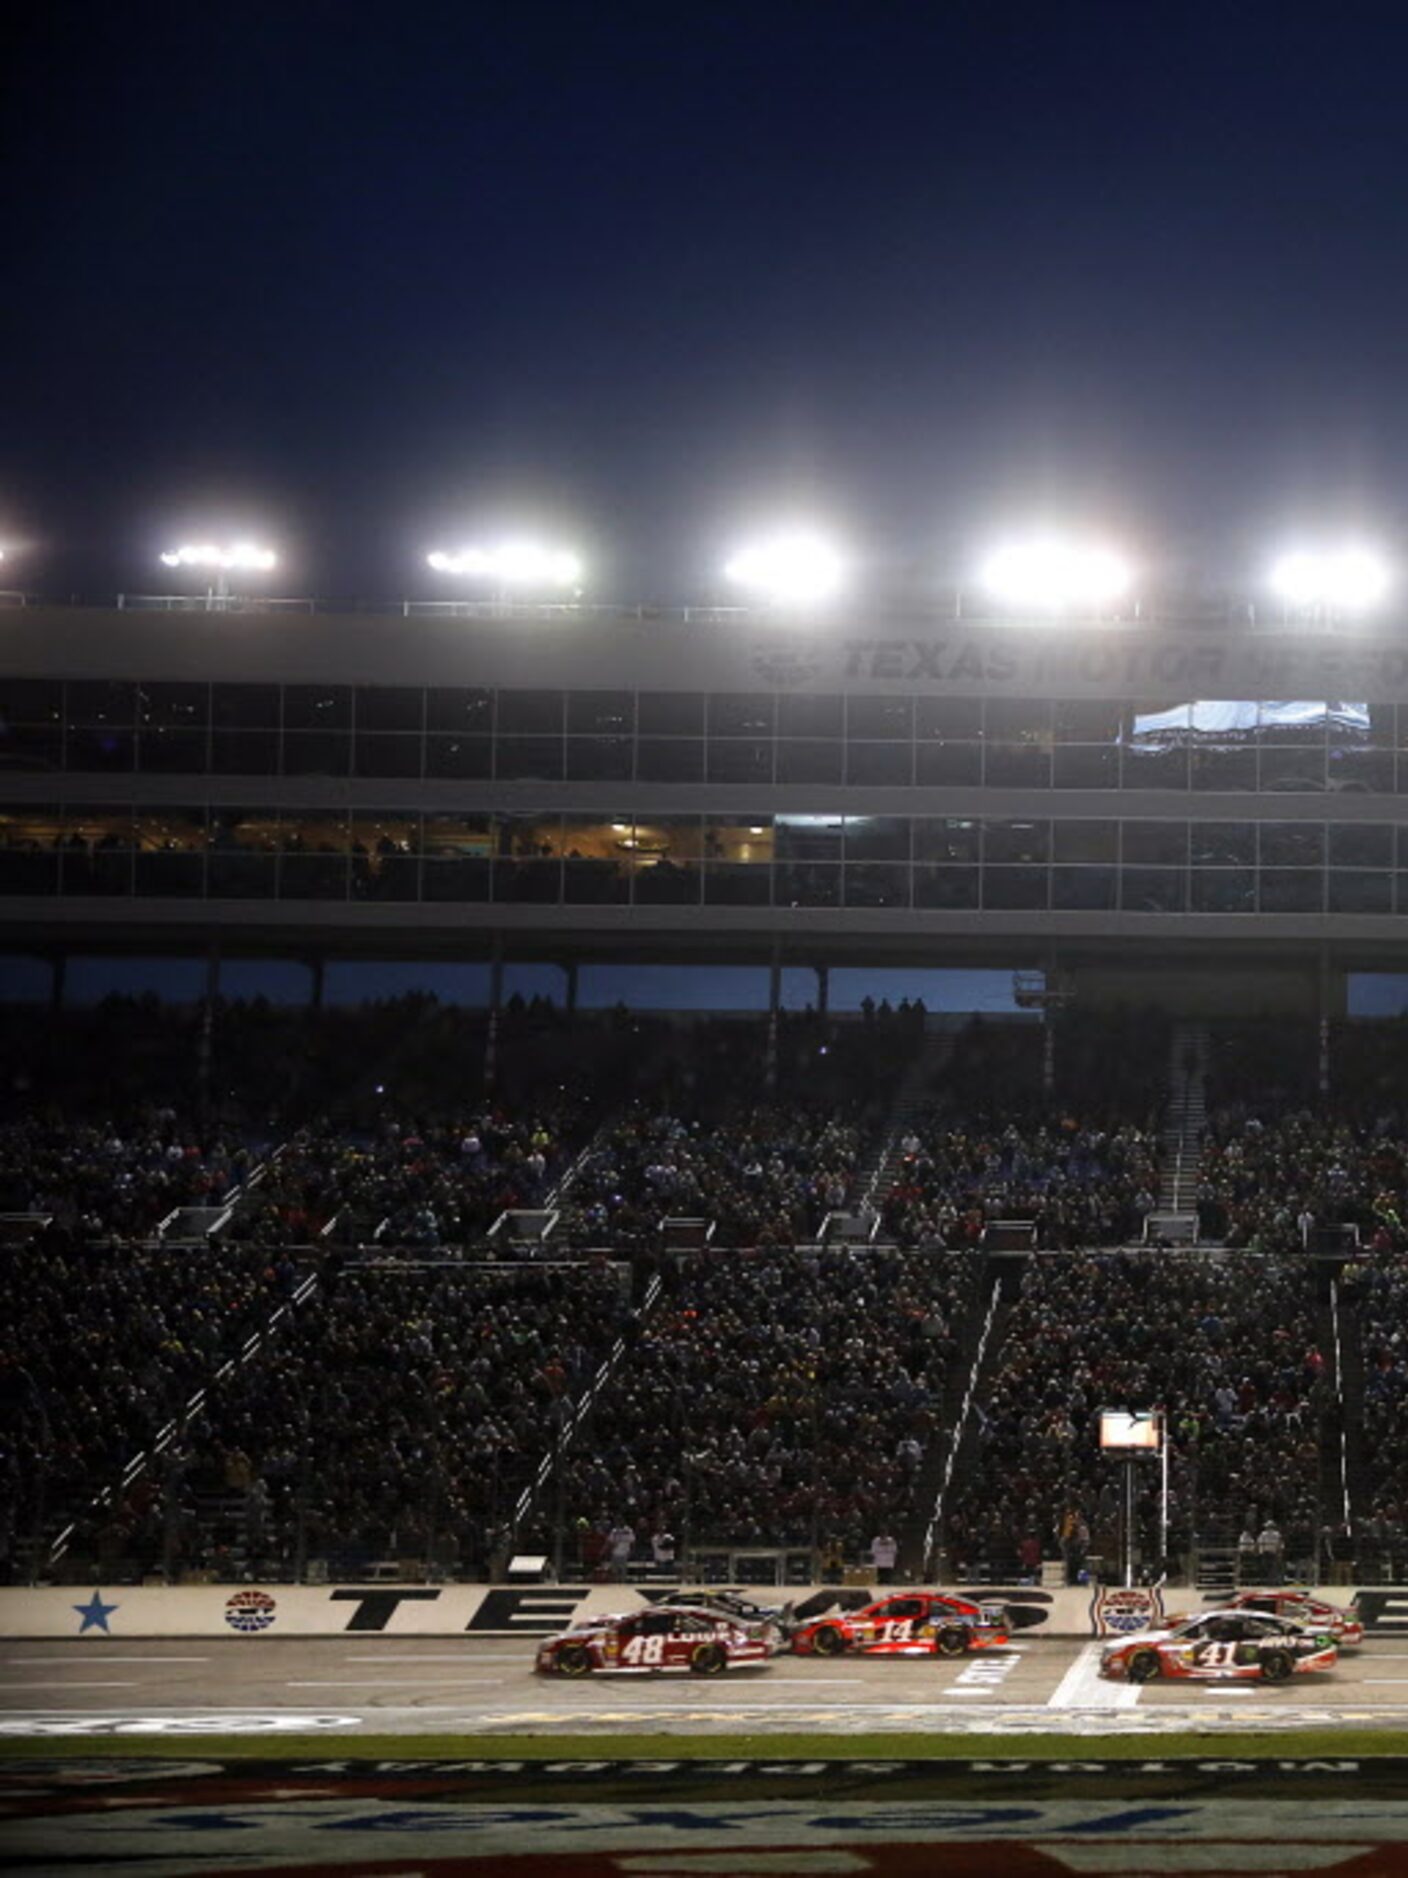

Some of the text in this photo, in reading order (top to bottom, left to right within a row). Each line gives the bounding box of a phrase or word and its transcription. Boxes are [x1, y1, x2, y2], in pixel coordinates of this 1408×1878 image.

[843, 643, 1014, 682] TEXAS
[879, 1618, 914, 1642] 14
[621, 1634, 664, 1665] 48
[1198, 1641, 1238, 1667] 41
